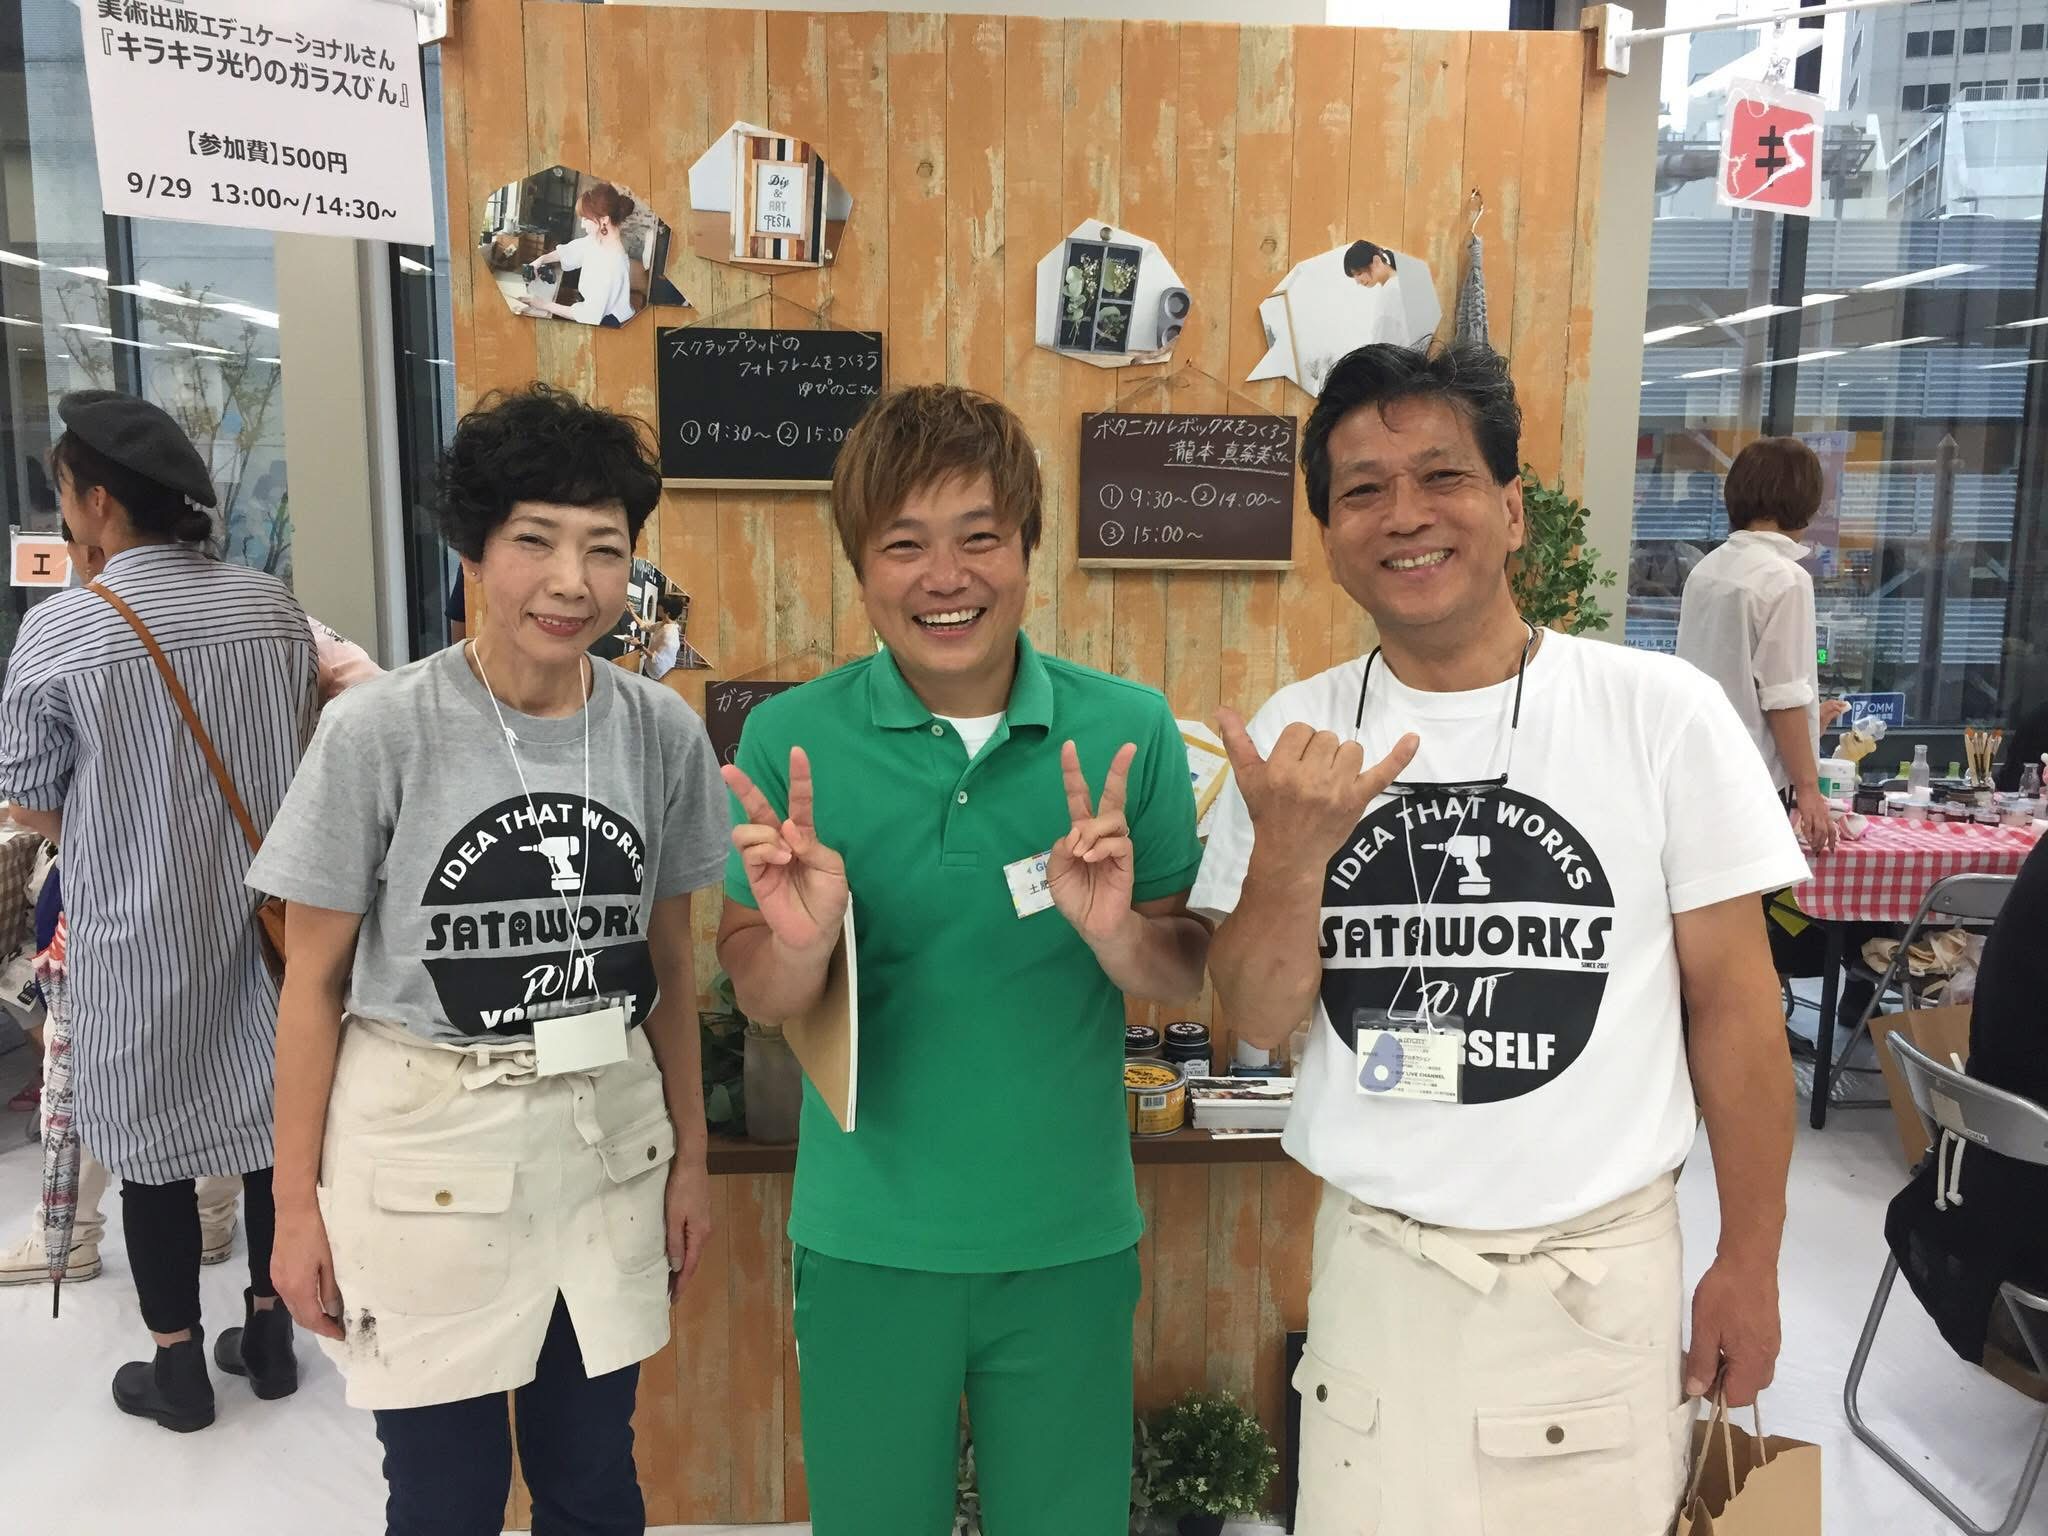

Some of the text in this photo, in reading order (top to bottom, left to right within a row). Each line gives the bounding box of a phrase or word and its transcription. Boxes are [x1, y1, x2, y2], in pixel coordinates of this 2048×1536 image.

[98, 0, 395, 71] 美術出版エデュケーショナルさん
[102, 27, 409, 107] 『キラキラ光りのガラスびん』
[188, 130, 347, 174] 【参加費】500円
[127, 172, 192, 199] 9/29
[764, 213, 791, 230] FESTA
[670, 332, 800, 358] スクラップウッドの
[739, 351, 878, 377] フォトフレームをつくろう
[1093, 417, 1290, 448] ボタニカルボックスをつくろう
[1867, 703, 1894, 713] OMM
[439, 803, 644, 891] IDEA THAT WORKS
[1330, 795, 1592, 891] IDEA THAT WORKS
[1319, 915, 1613, 961] SATAWORKS
